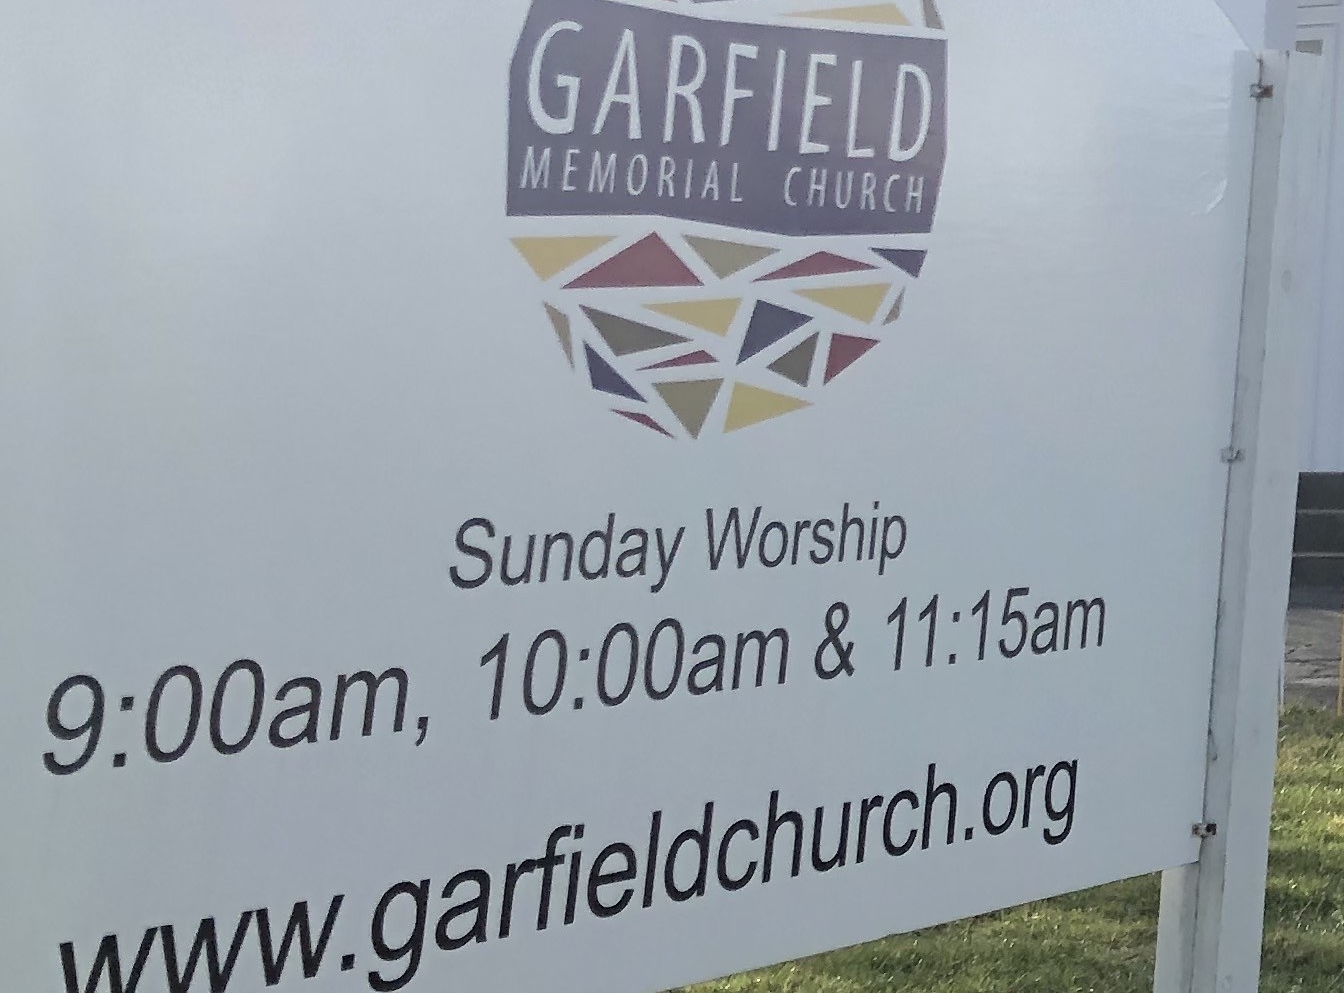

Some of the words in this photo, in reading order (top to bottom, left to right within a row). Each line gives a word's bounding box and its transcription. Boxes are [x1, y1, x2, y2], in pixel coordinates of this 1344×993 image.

[526, 20, 933, 162] GARFIELD
[519, 145, 743, 203] MEMORIAL
[783, 166, 926, 213] CHURCH
[449, 512, 685, 593] Sunday
[705, 501, 908, 575] Worship
[42, 658, 430, 776] 9:00am,
[479, 617, 791, 721] 10:00am
[814, 601, 856, 680] &
[886, 587, 1106, 671] 11:15am
[58, 758, 1079, 993] www.garfieldchurch.org
